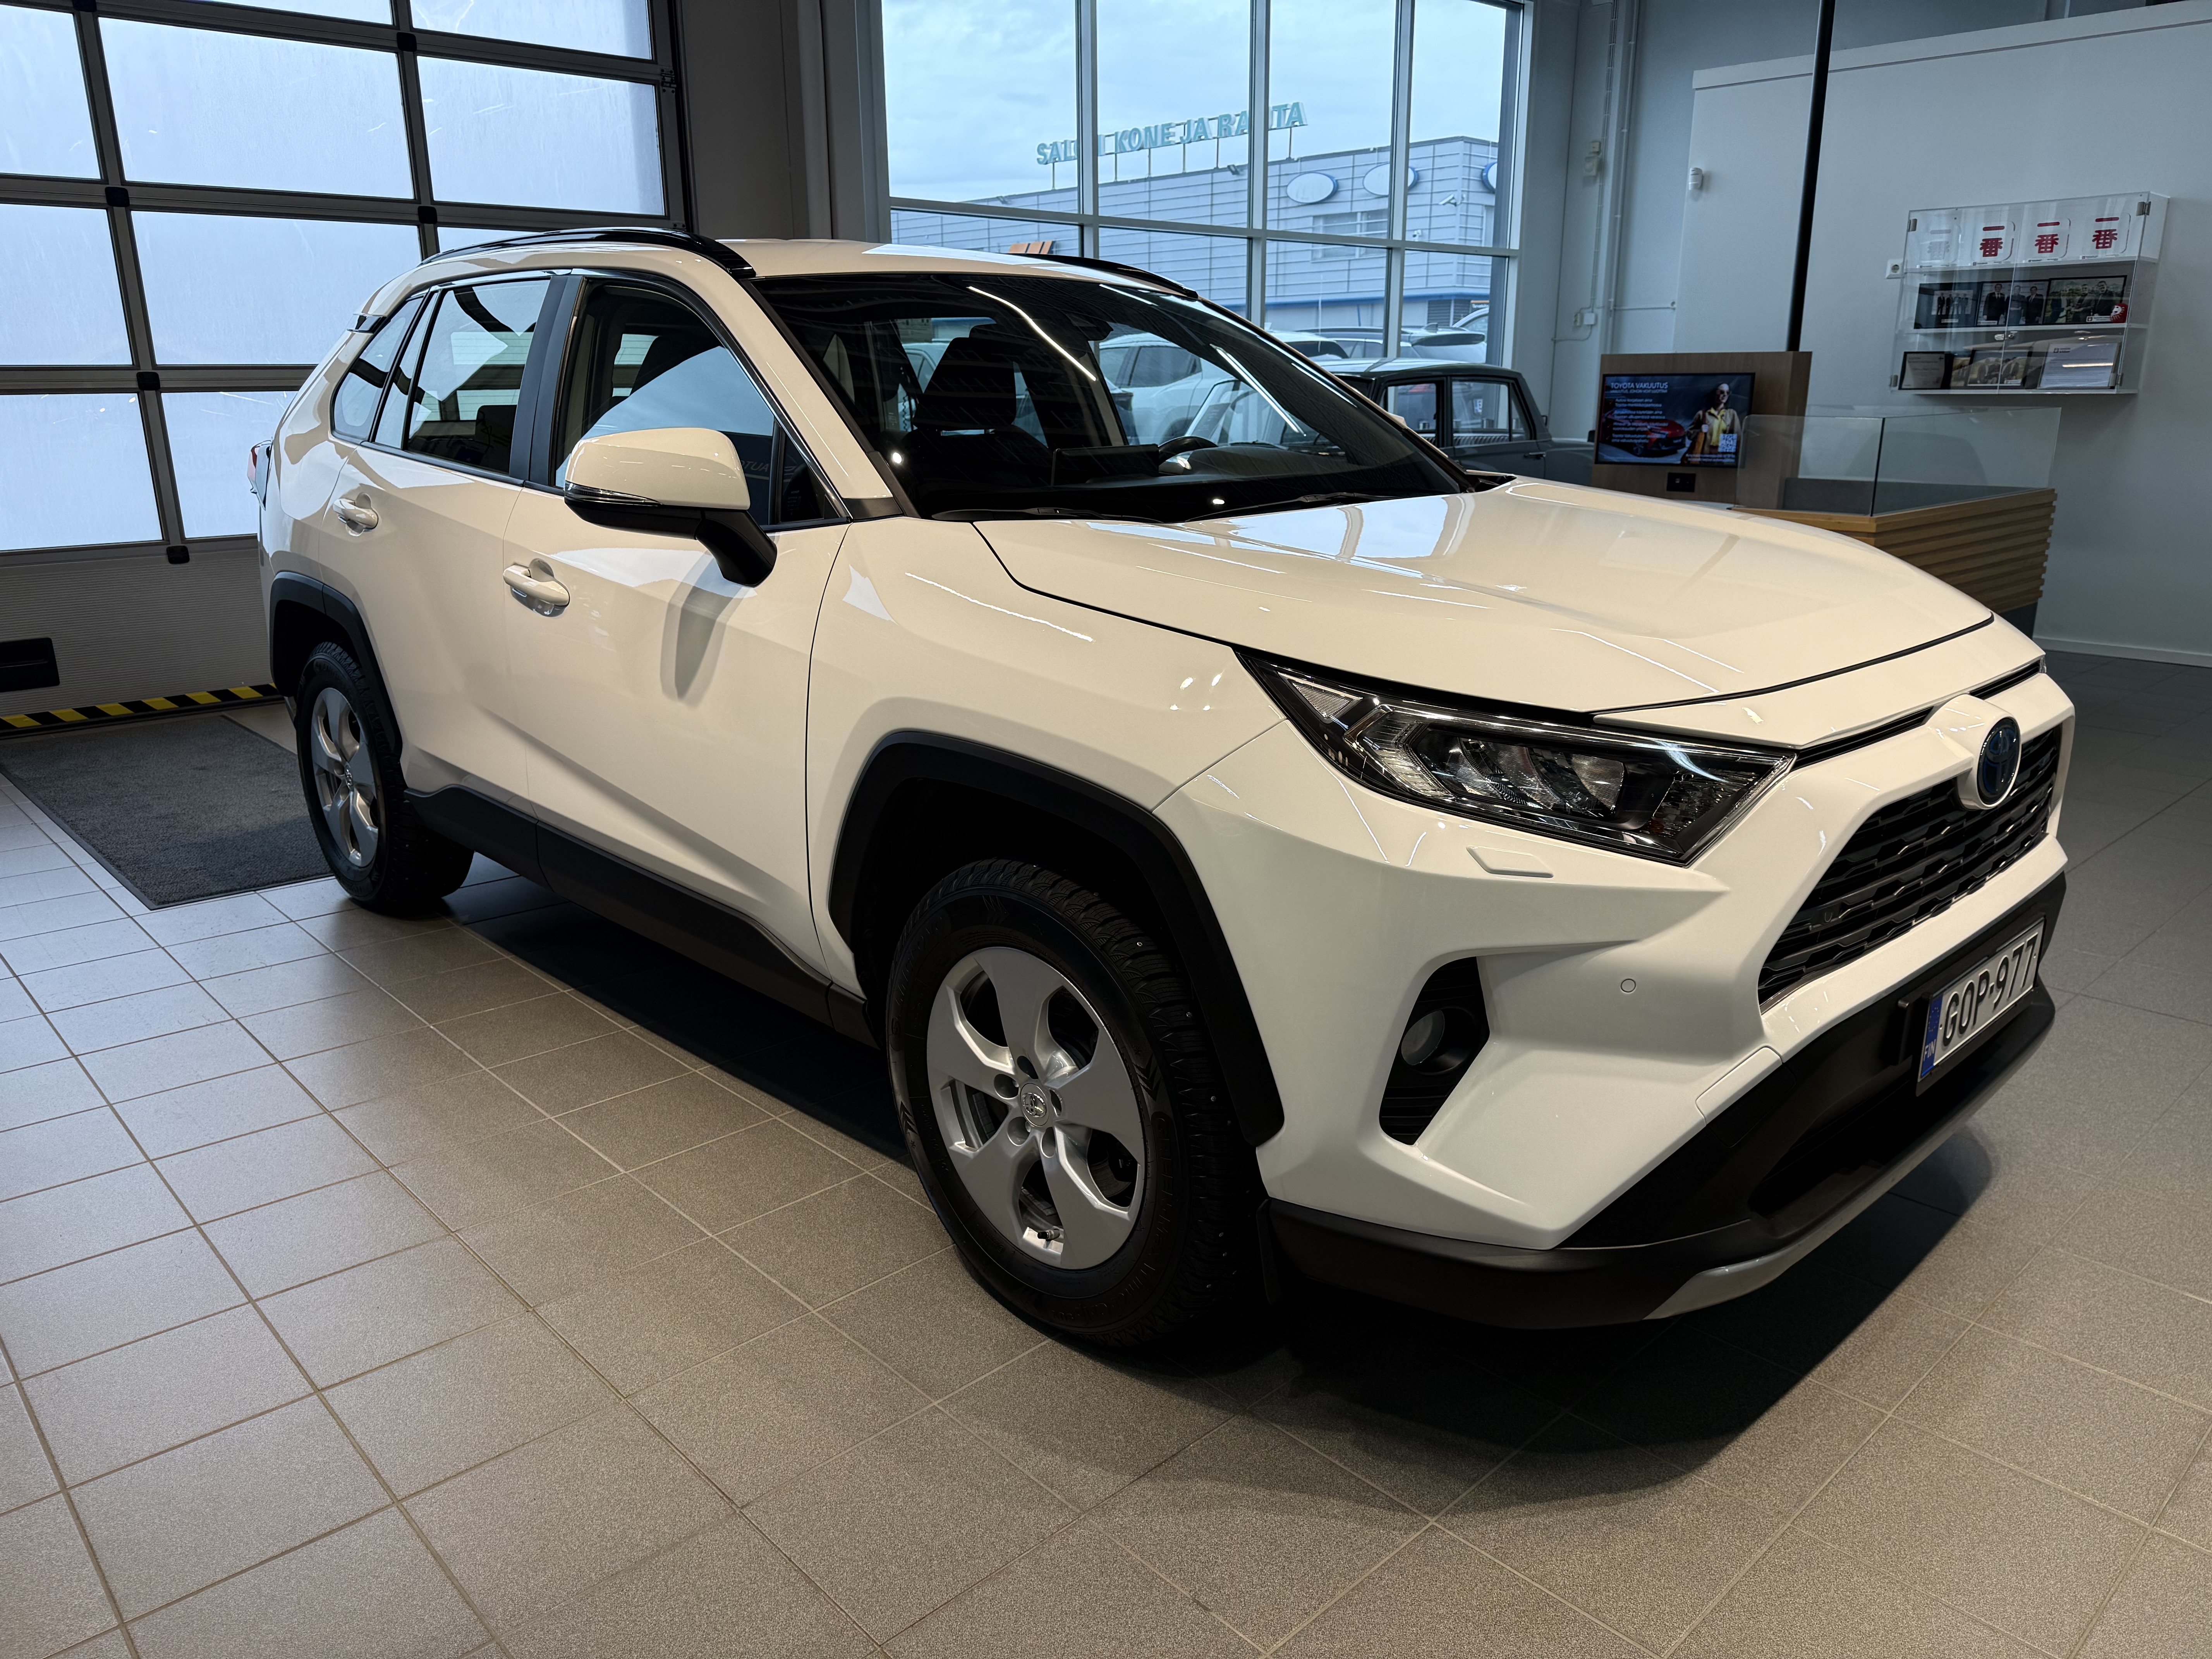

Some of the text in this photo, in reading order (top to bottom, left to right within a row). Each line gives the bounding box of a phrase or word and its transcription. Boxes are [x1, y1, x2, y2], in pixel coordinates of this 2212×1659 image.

[1037, 101, 1308, 165] SAL KONE JA RATA
[1942, 931, 2039, 1047] GOP-977
[1923, 1038, 1937, 1062] FIN
